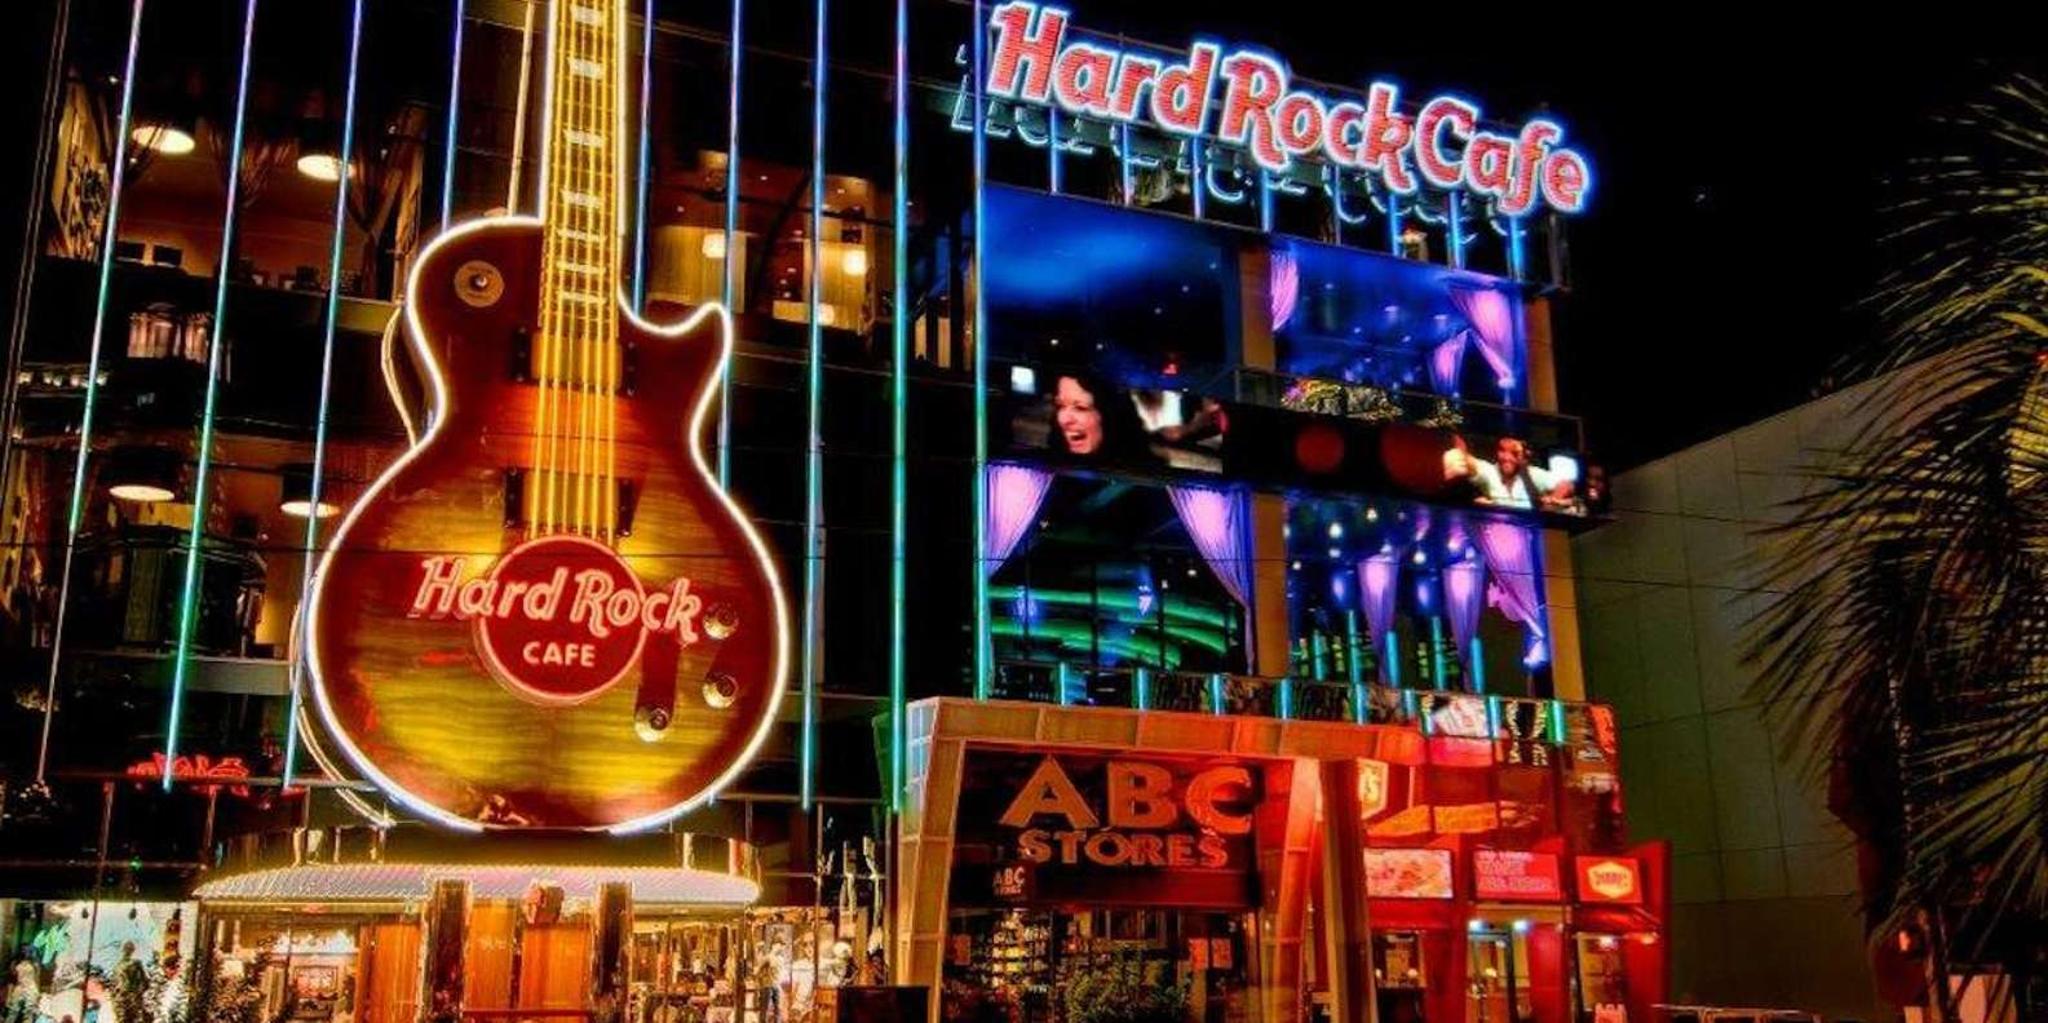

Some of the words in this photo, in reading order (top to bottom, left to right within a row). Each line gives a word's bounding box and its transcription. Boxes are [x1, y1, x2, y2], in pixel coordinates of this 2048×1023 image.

[988, 2, 1219, 133] Hard
[1220, 49, 1416, 193] Rock
[1414, 97, 1590, 214] Cafe
[413, 555, 569, 622] Hard
[569, 568, 702, 644] Rock
[522, 641, 597, 668] CAFE
[998, 756, 1254, 835] ABC
[992, 866, 1026, 888] ABC
[1017, 827, 1229, 868] STORES
